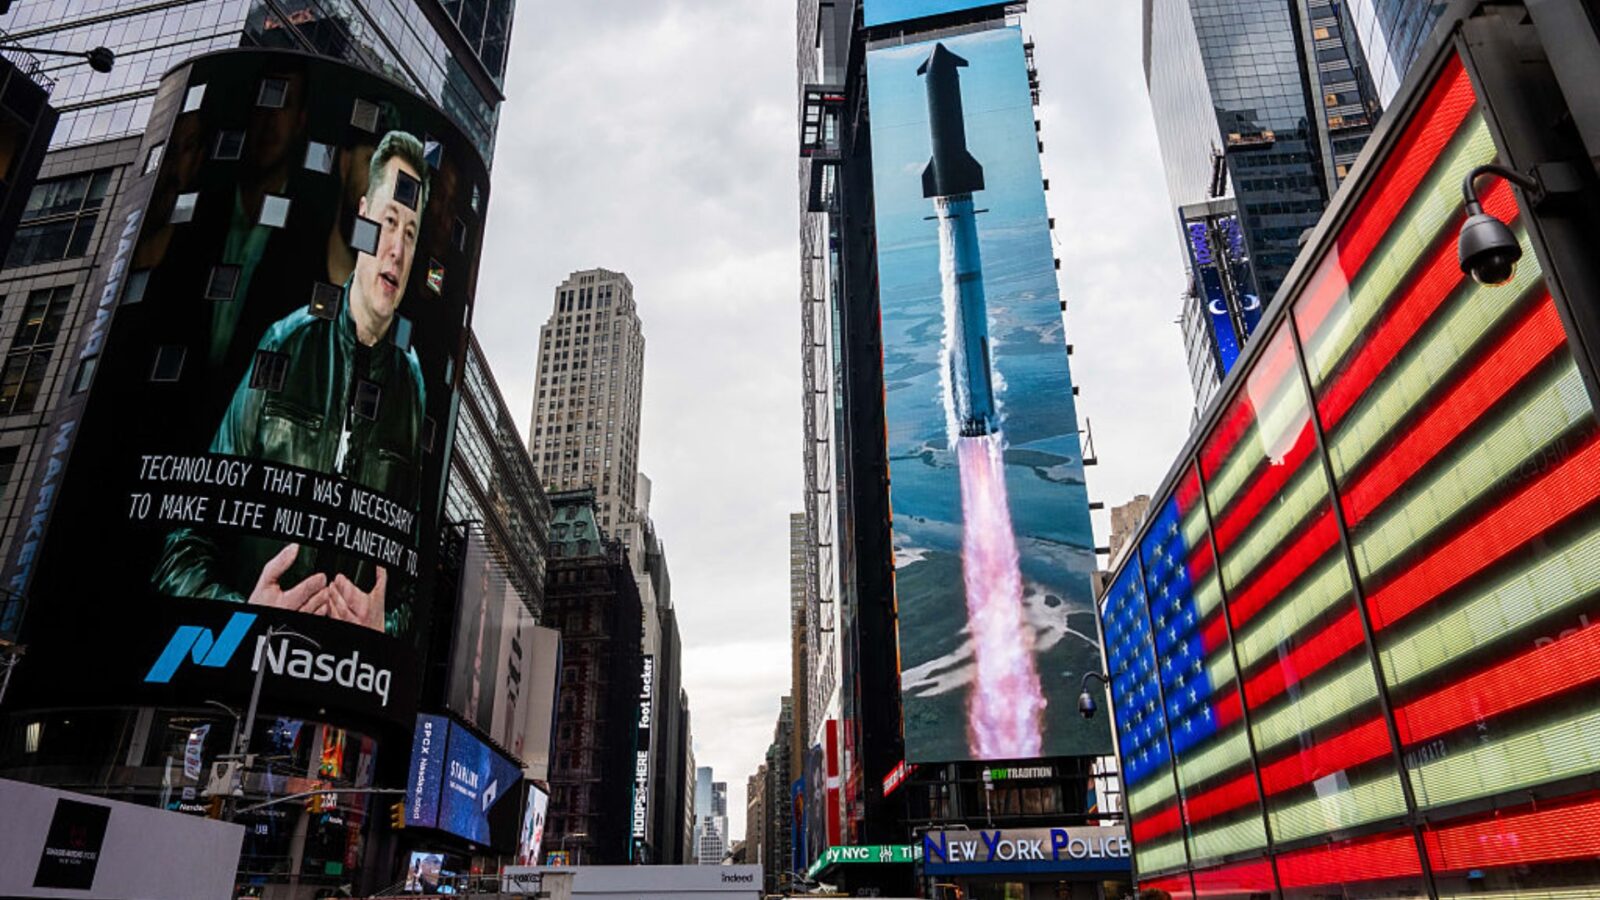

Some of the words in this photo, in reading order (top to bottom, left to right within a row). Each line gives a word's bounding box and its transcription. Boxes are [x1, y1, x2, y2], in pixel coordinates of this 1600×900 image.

[80, 209, 142, 360] NASDAQ
[139, 454, 252, 487] TECHNOLOGY
[262, 466, 306, 497] THAT
[313, 476, 343, 507] WAS
[350, 488, 414, 535] NECESSARY
[129, 493, 151, 520] TO
[158, 494, 209, 522] MAKE
[218, 499, 266, 529] LIFE
[273, 507, 404, 566] MULTI-PLANETARY
[251, 635, 392, 707] Nasdaq
[640, 657, 653, 699] Locker
[638, 701, 651, 729] Foot
[636, 750, 648, 782] HERE
[989, 766, 1053, 780] EWTRADITION
[632, 796, 646, 838] HOOPS
[842, 847, 870, 859] NYC
[924, 831, 977, 863] NEW
[980, 831, 1043, 862] YORK
[1050, 829, 1130, 861] POLICE
[721, 872, 753, 883] indeed
